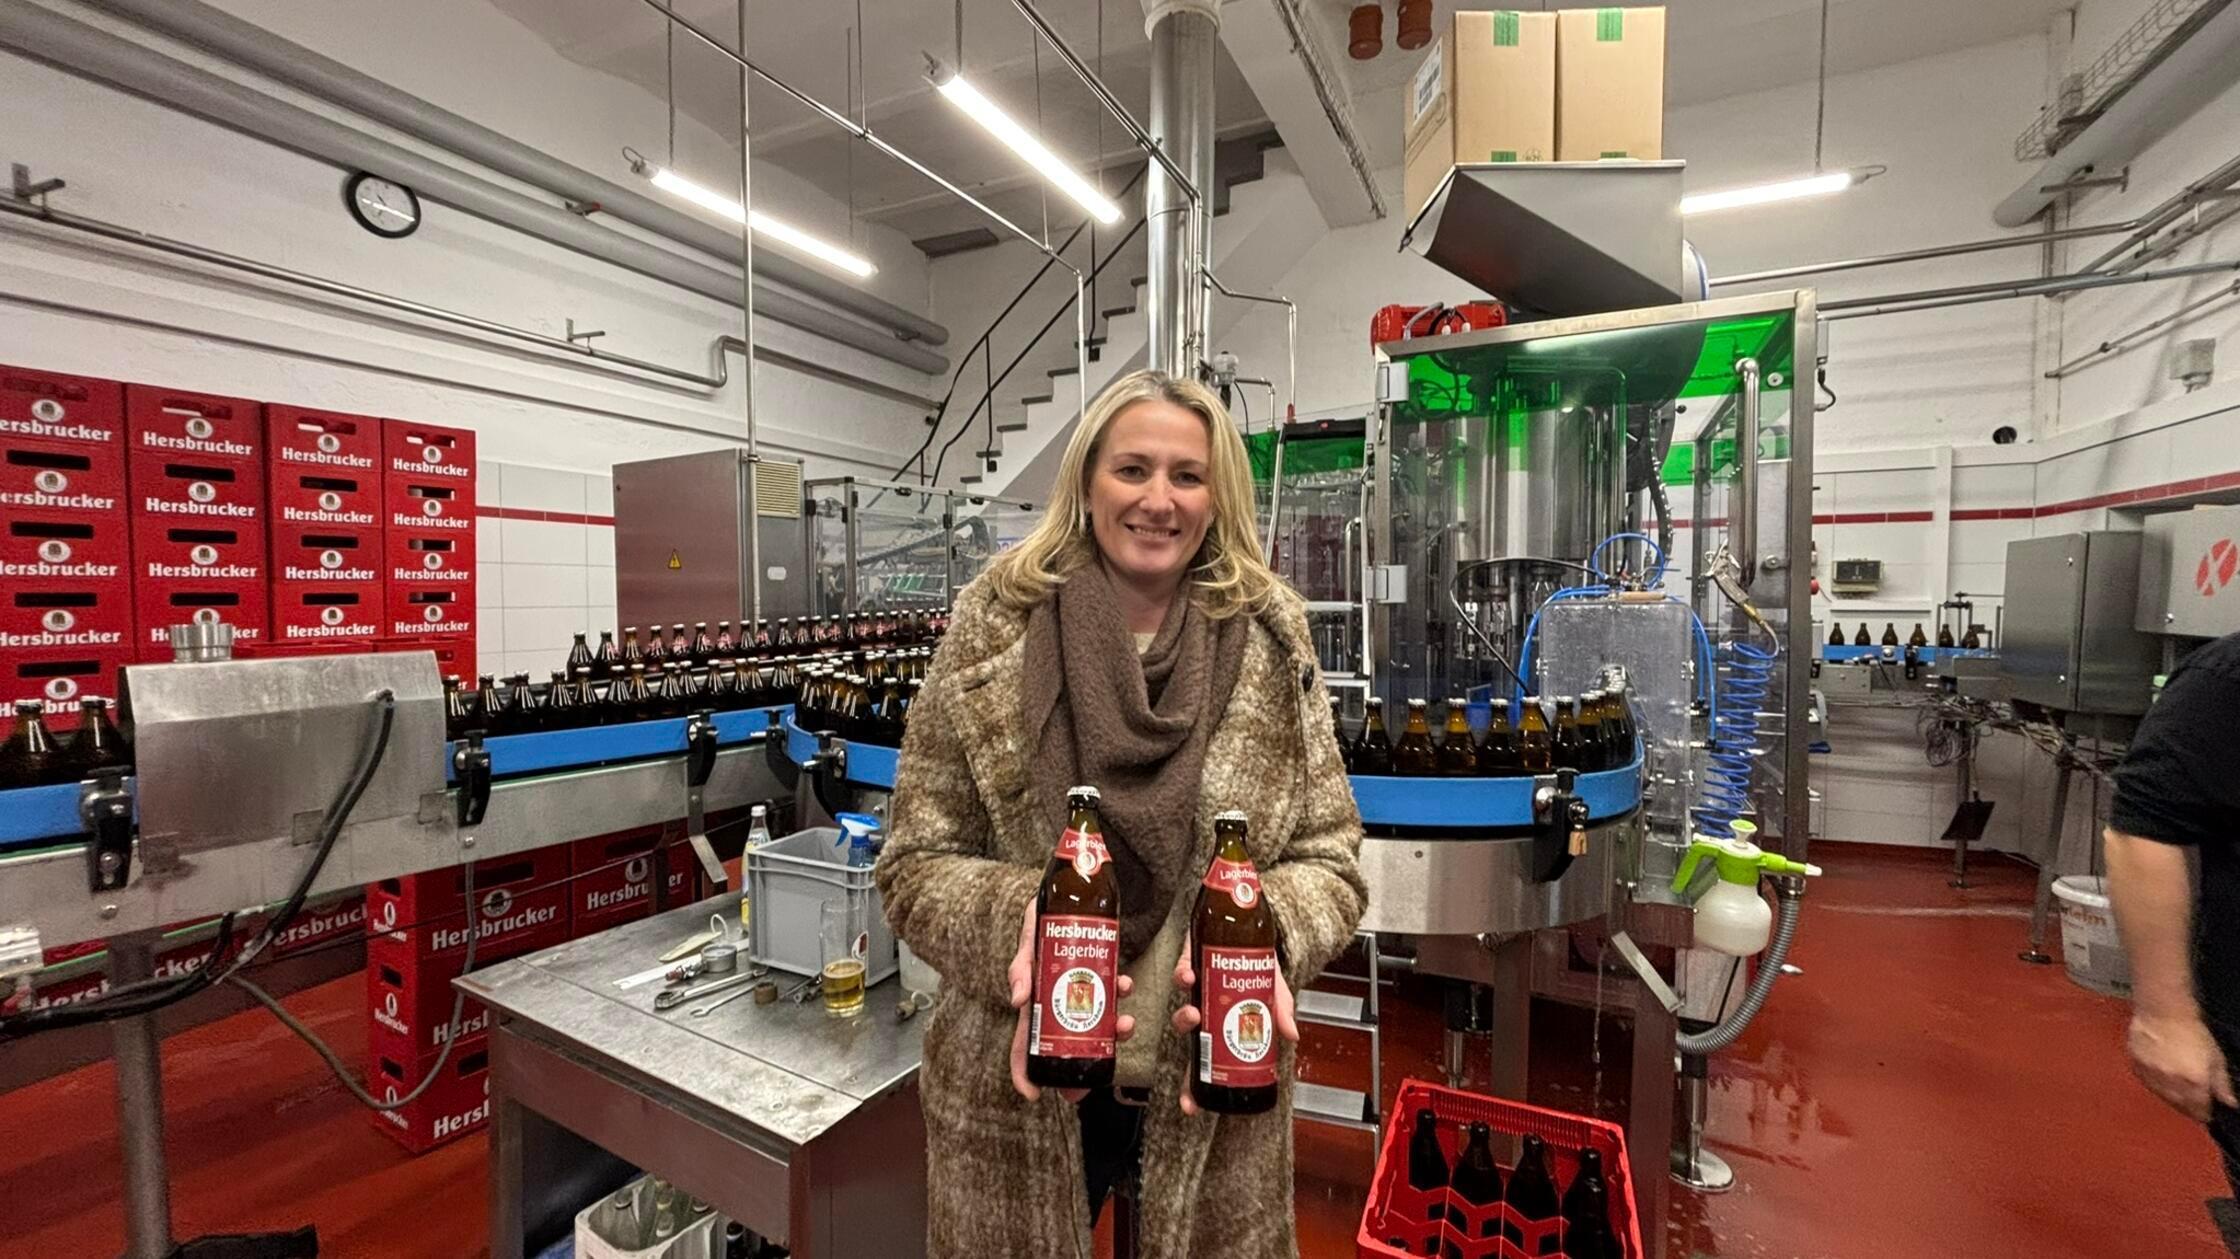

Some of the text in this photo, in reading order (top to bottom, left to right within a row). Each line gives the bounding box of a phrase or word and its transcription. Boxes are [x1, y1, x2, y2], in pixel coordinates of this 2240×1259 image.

[0, 419, 112, 441] ersbrucker
[142, 431, 253, 455] Hersbrucker
[282, 446, 373, 468] Hersbrucker
[393, 458, 469, 477] Hersbrucker
[0, 489, 115, 509] ersbrucker
[146, 497, 256, 518] Hersbrucker
[283, 506, 374, 524] Hersbrucker
[393, 513, 469, 529] Hersbrucker
[0, 561, 118, 577] ersbrucker
[149, 563, 257, 578] Hersbrucker
[285, 566, 375, 580] Hersbrucker
[394, 567, 469, 580] Hersbrucker
[287, 622, 376, 638] Hersbrucker
[395, 620, 469, 634] Hersbrucker
[587, 872, 684, 911] Hersbruer
[272, 902, 368, 946] ersbruc
[1046, 921, 1117, 942] Hersbrucker
[1054, 941, 1109, 960] Lagerbier
[1211, 952, 1275, 971] Hersbrucke
[1222, 973, 1272, 993] Lagerbier
